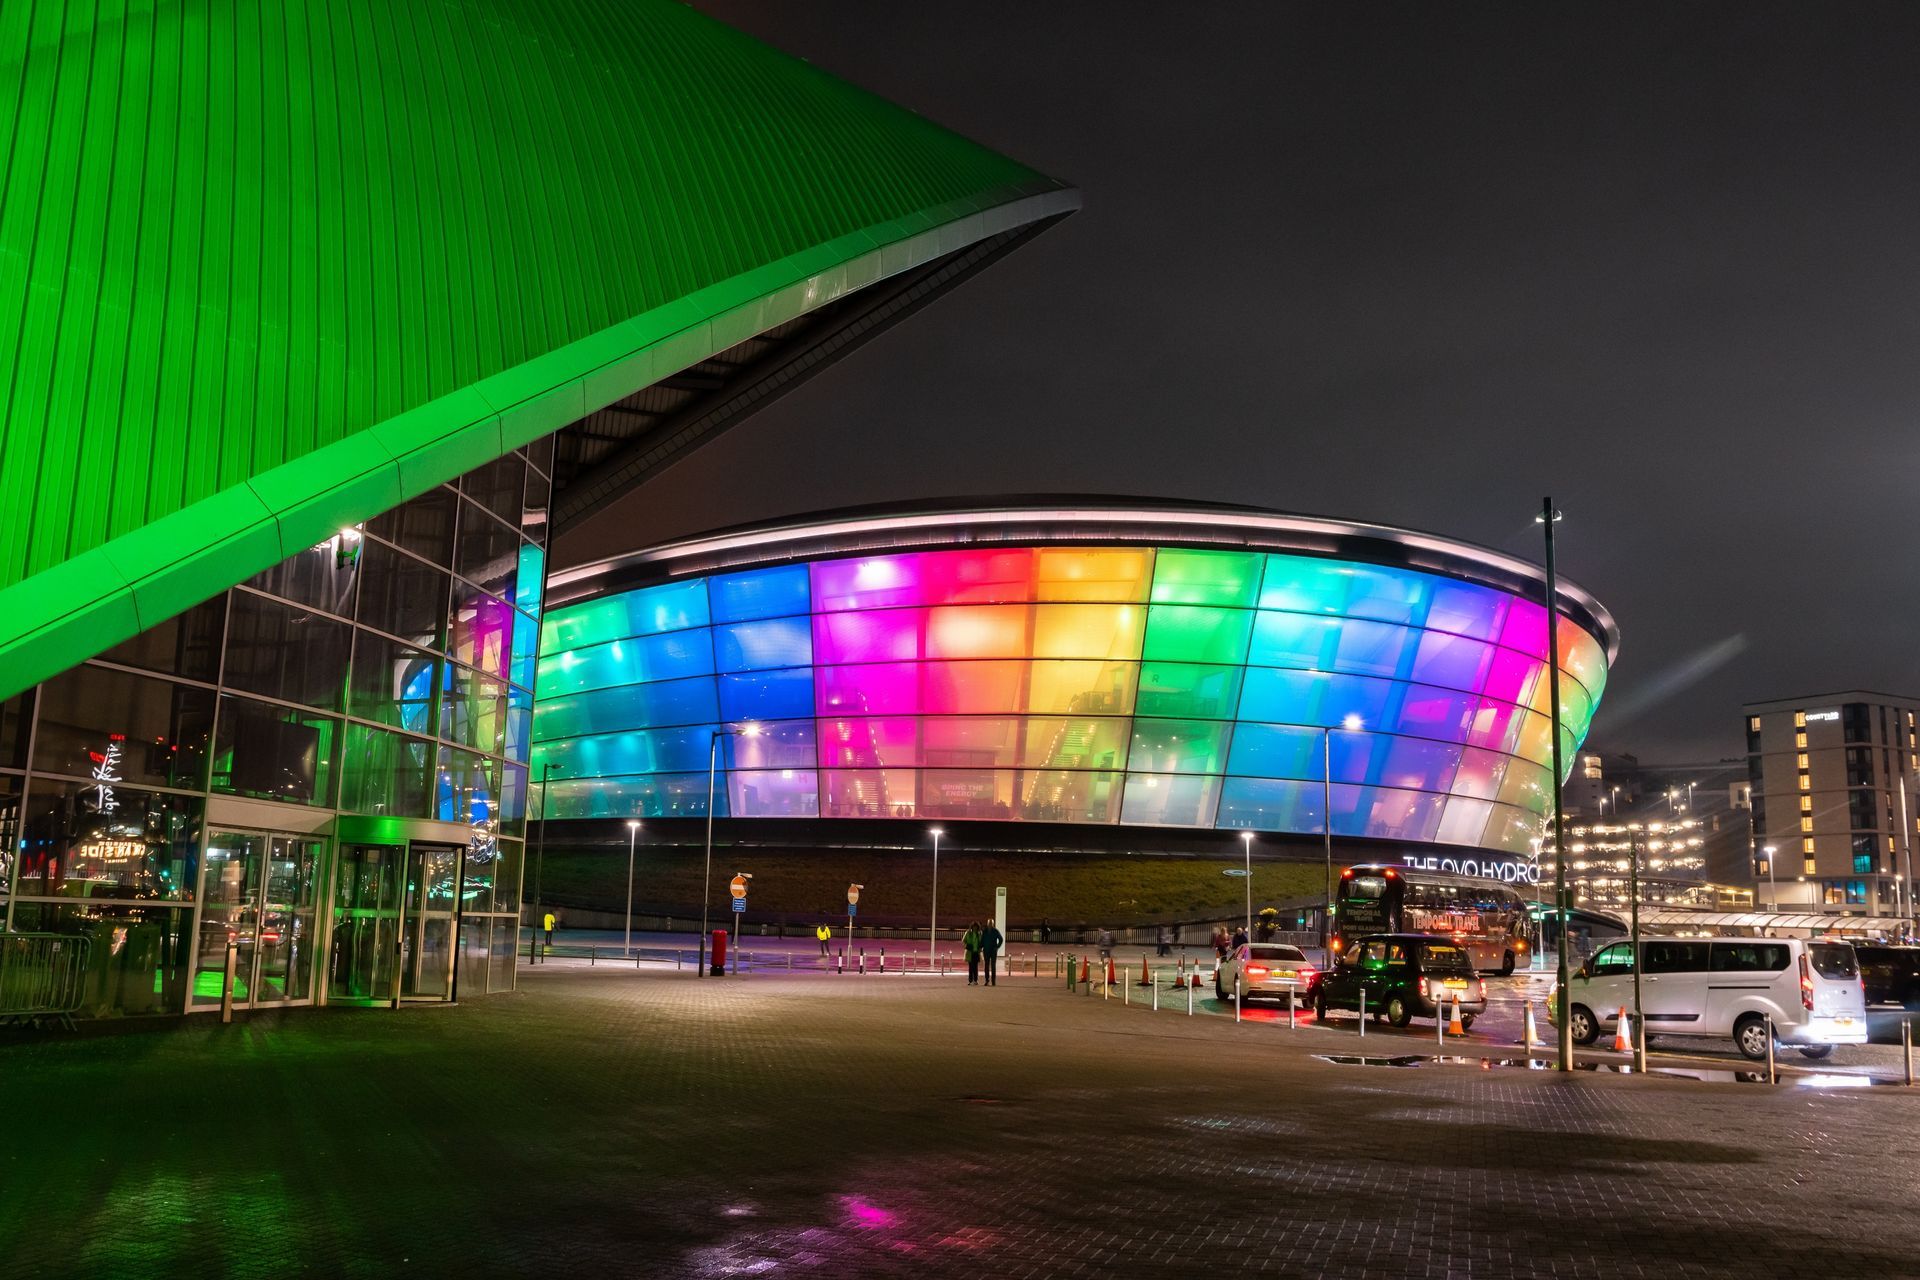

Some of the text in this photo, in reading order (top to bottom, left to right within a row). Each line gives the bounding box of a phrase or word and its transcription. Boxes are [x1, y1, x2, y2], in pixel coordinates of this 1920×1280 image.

[1403, 856, 1540, 883] THE OVO HYDRO
[1412, 914, 1452, 930] TEMPORAL
[1455, 915, 1480, 931] TRAVEL
